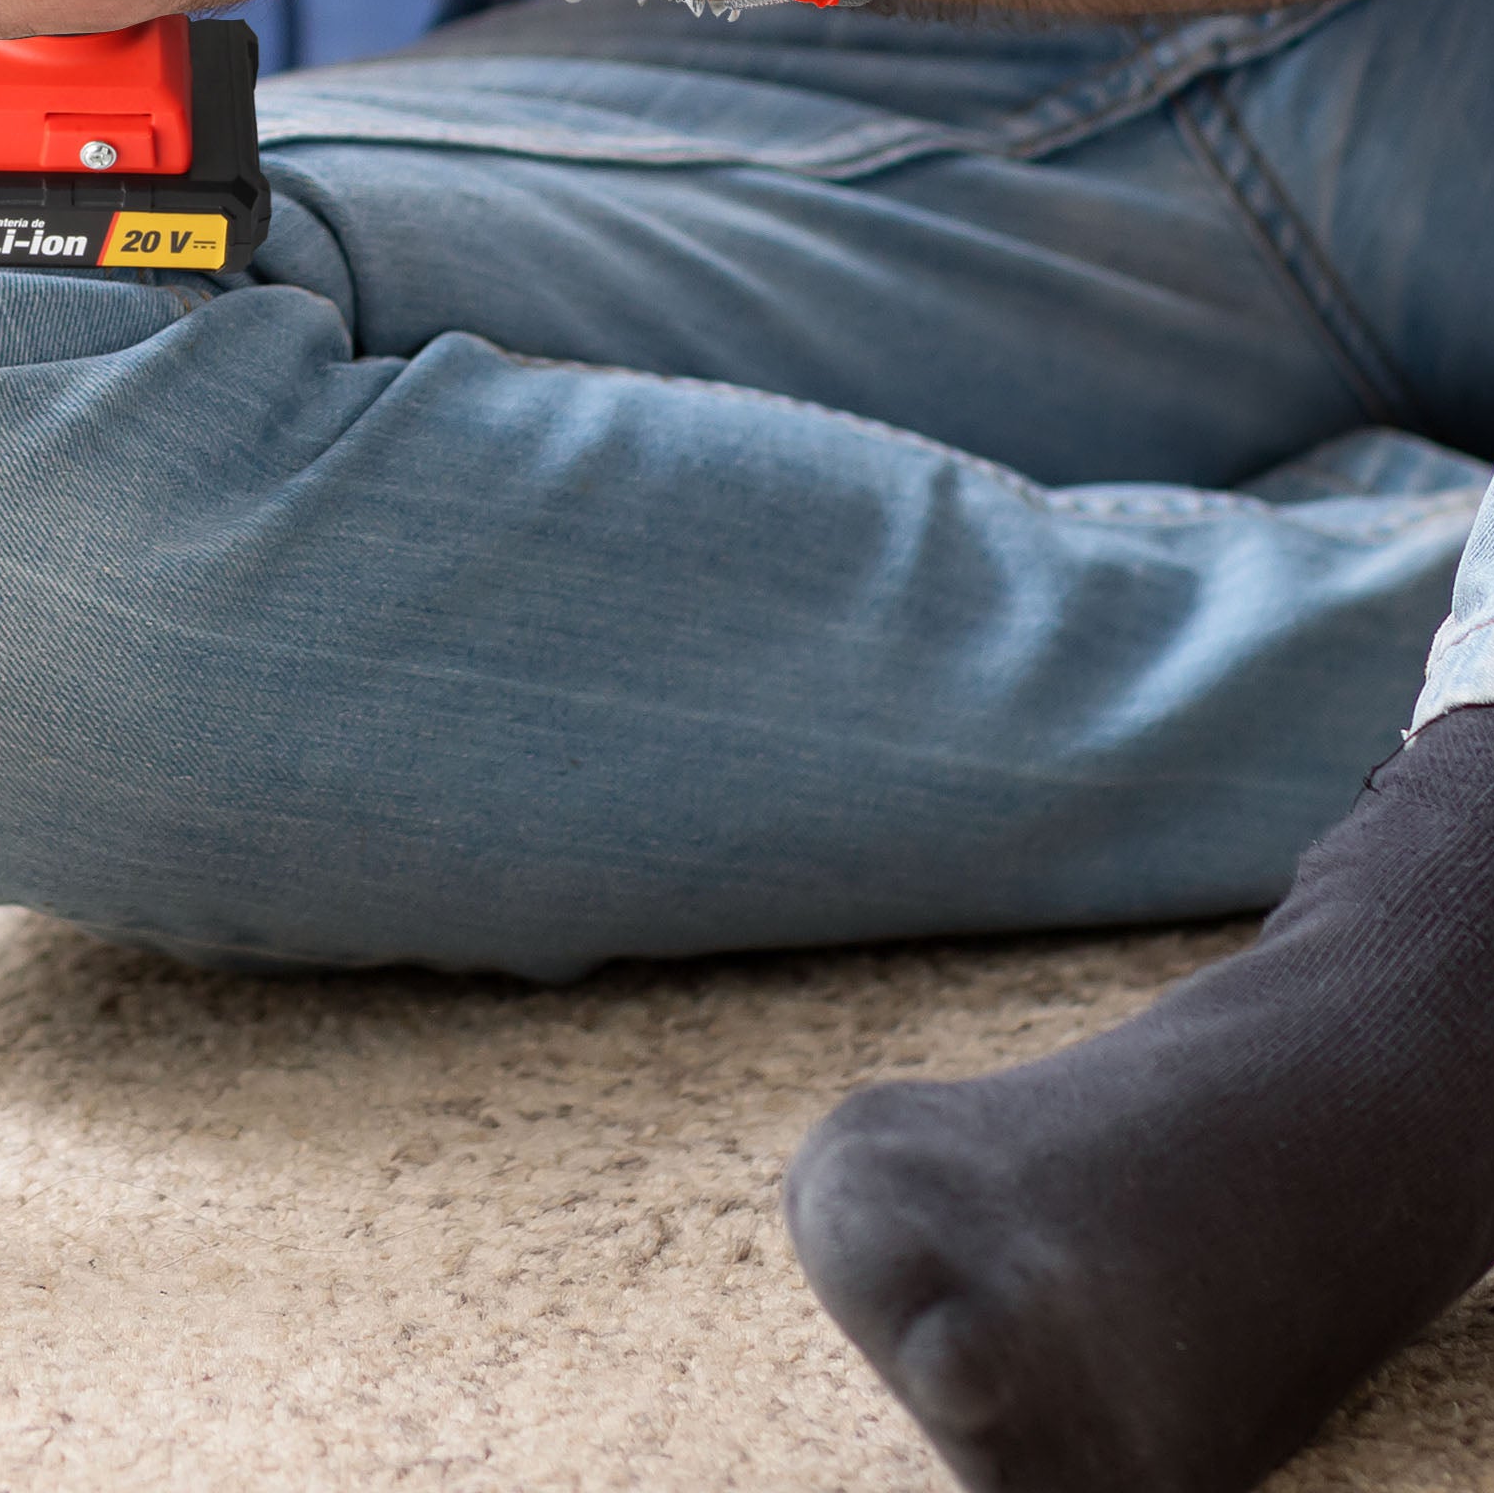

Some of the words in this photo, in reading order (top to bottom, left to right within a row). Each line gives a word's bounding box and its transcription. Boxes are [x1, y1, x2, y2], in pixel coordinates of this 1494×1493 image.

[31, 218, 45, 228] de
[120, 230, 161, 253] 20
[169, 231, 193, 254] V
